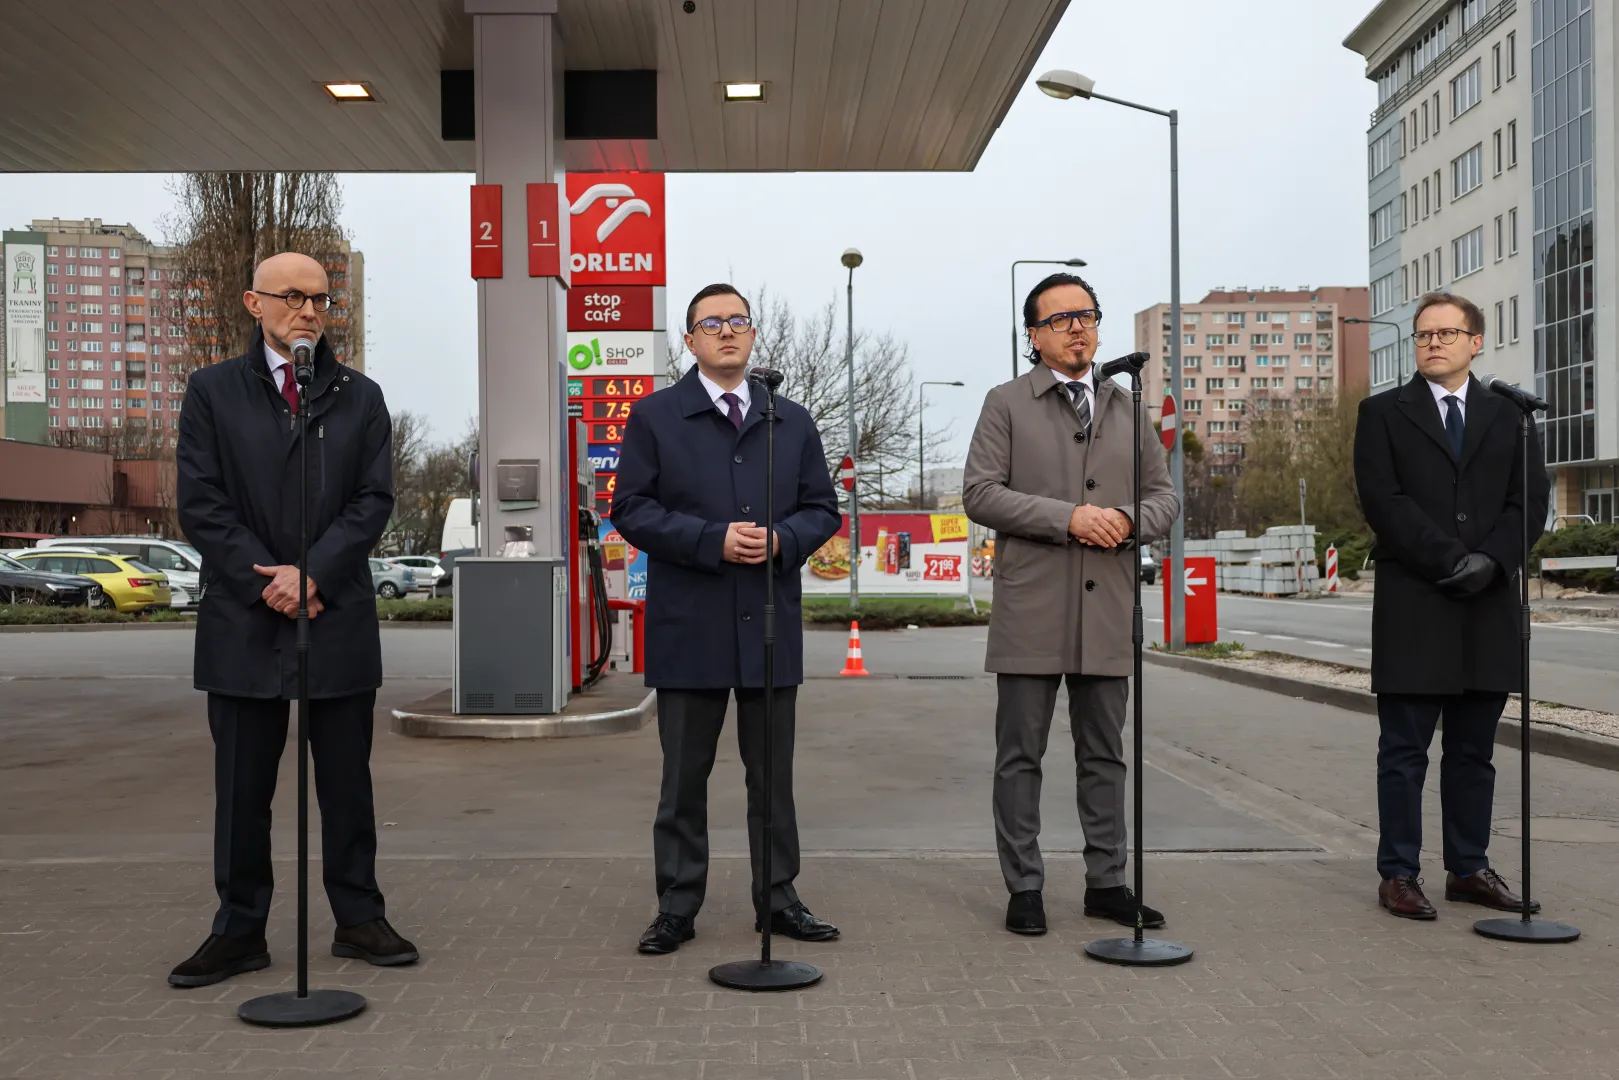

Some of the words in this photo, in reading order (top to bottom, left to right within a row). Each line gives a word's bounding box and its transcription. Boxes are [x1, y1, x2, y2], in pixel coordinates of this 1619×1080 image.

[479, 221, 493, 240] 2
[538, 220, 548, 239] 1
[570, 253, 653, 273] ORLEN
[584, 308, 621, 323] cafe
[606, 347, 644, 358] SHOP
[569, 387, 581, 396] 95
[605, 380, 644, 396] 6.16
[606, 402, 631, 418] 7.5
